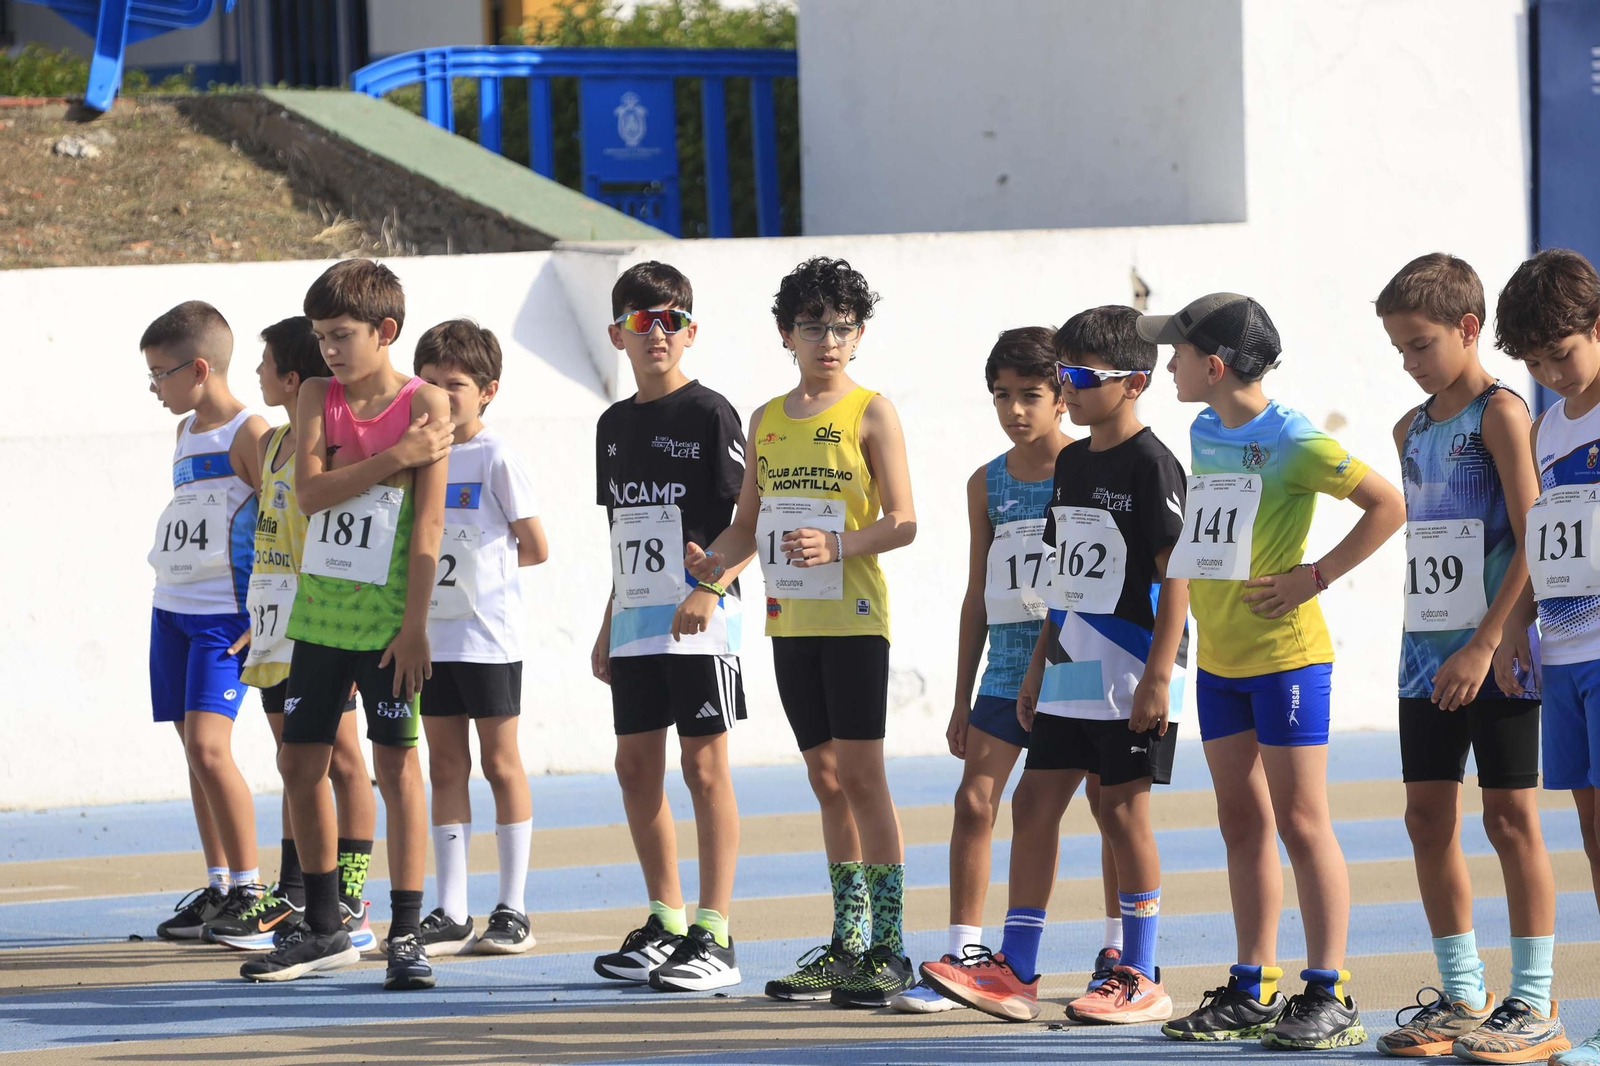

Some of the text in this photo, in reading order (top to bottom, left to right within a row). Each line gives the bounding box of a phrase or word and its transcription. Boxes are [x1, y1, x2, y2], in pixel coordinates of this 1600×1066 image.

[768, 466, 853, 481] CLUB ATLETISMO
[772, 479, 842, 493] MONTILLA
[615, 481, 687, 505] UCAMP
[160, 518, 209, 552] 194
[318, 509, 373, 550] 181
[1190, 506, 1238, 544] 141
[1538, 519, 1586, 562] 131
[262, 547, 291, 568] CÁDIZ
[617, 537, 666, 575] 178
[1057, 539, 1107, 580] 162
[1408, 555, 1464, 595] 139
[376, 701, 413, 719] SJA
